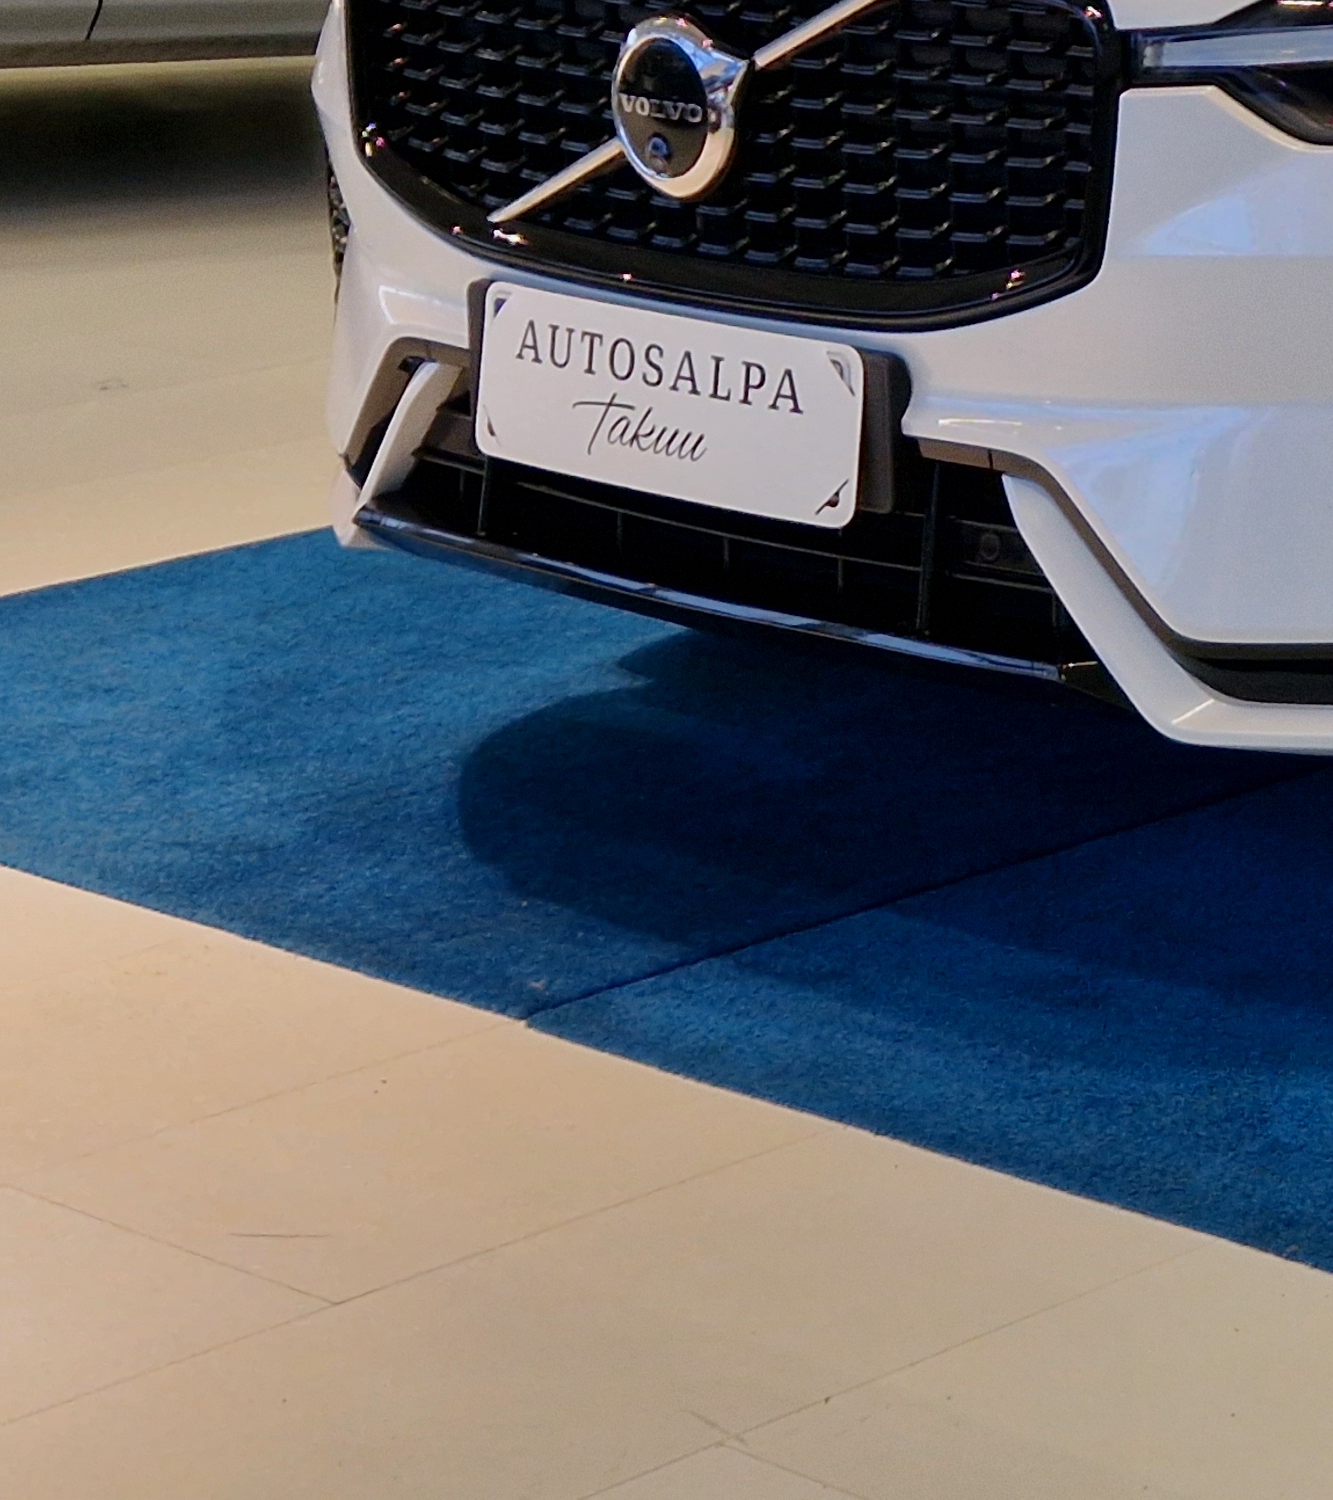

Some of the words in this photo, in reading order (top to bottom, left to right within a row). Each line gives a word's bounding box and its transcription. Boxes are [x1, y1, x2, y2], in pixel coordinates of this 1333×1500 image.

[618, 93, 703, 123] VOLVO
[516, 318, 804, 415] AUTOSALPA
[572, 392, 709, 462] Takuu
